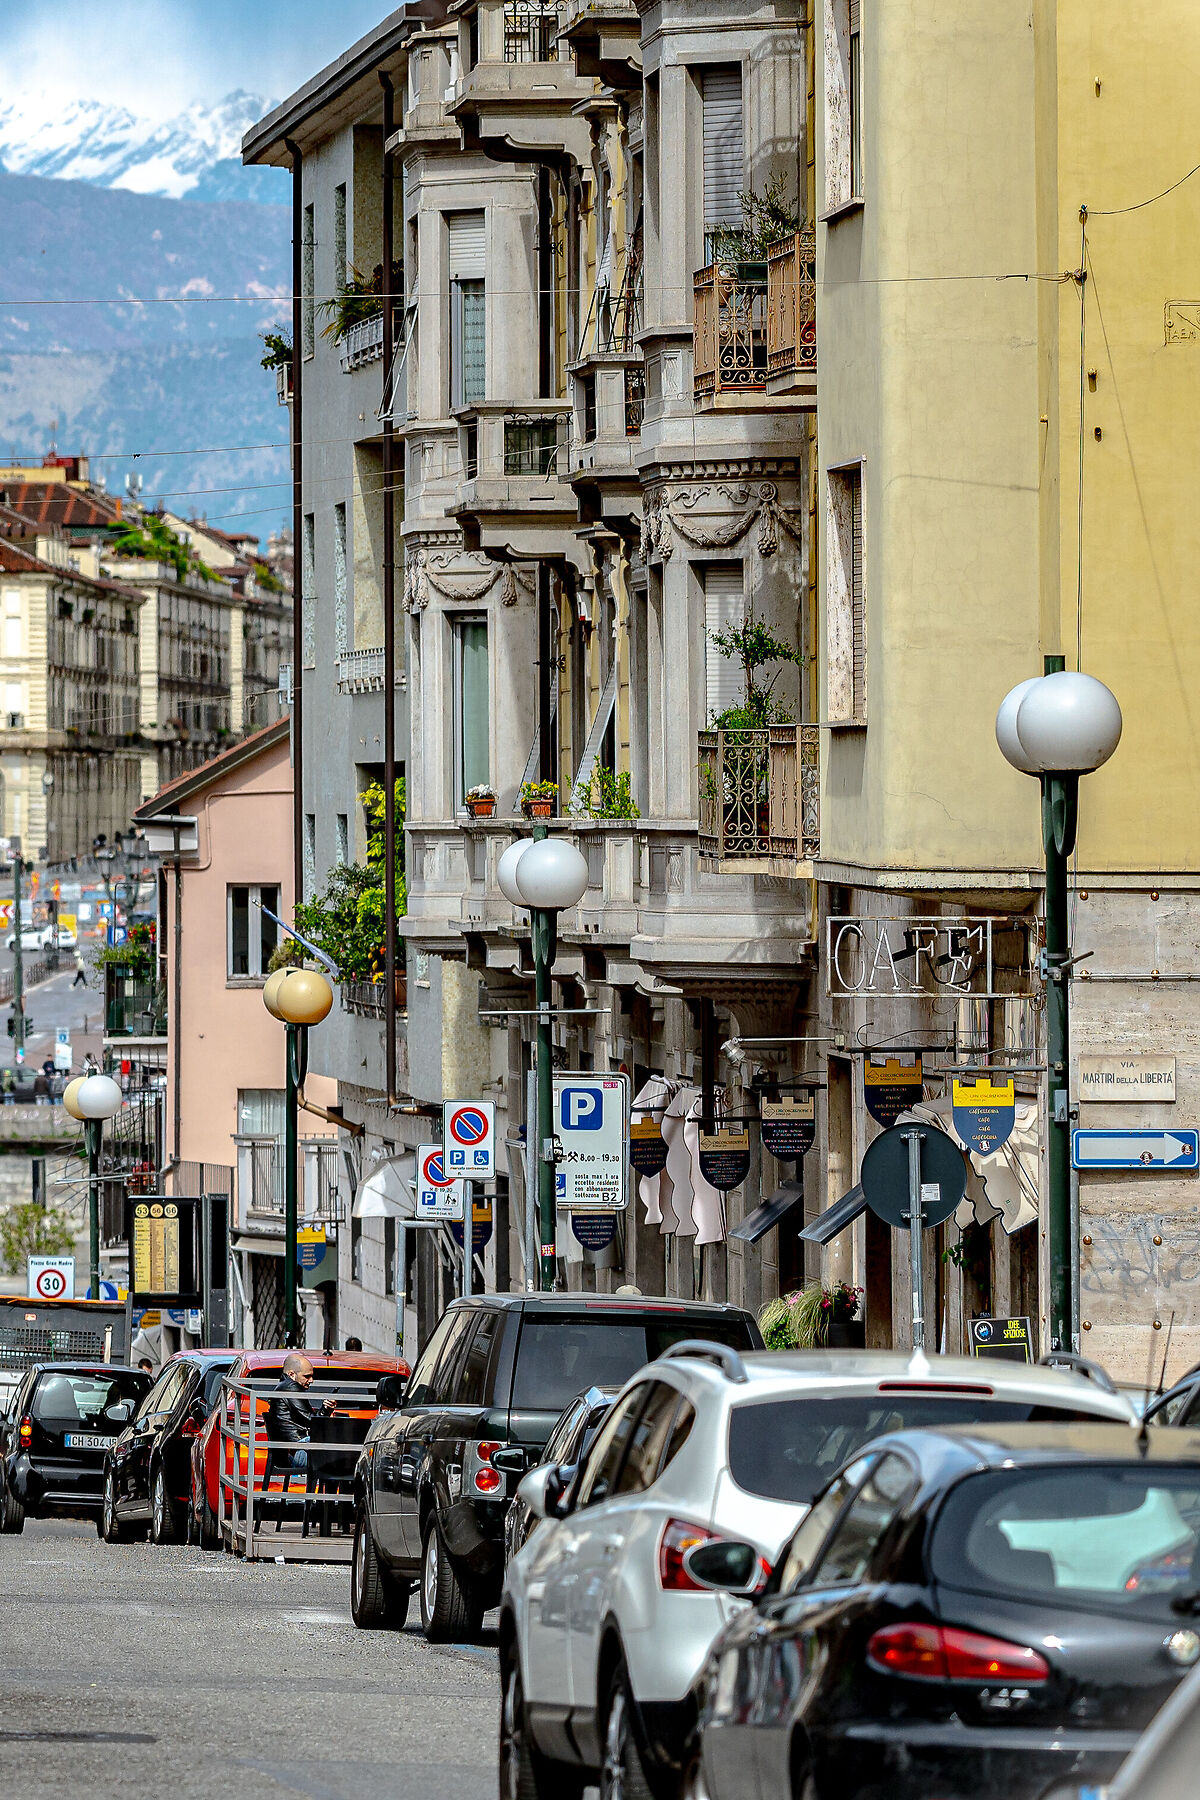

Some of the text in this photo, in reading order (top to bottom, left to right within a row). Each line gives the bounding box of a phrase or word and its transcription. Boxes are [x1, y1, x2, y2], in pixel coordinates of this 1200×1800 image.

[1082, 1072, 1115, 1084] MARTIRI
[569, 1092, 596, 1126] P
[453, 1152, 462, 1164] P
[424, 1194, 434, 1204] P
[602, 1193, 617, 1202] B2
[136, 1207, 148, 1215] 53
[166, 1207, 176, 1215] 66
[44, 1277, 60, 1291] 30
[1007, 1320, 1020, 1329] IDEE
[72, 1436, 84, 1447] CH
[87, 1437, 105, 1448] 304
